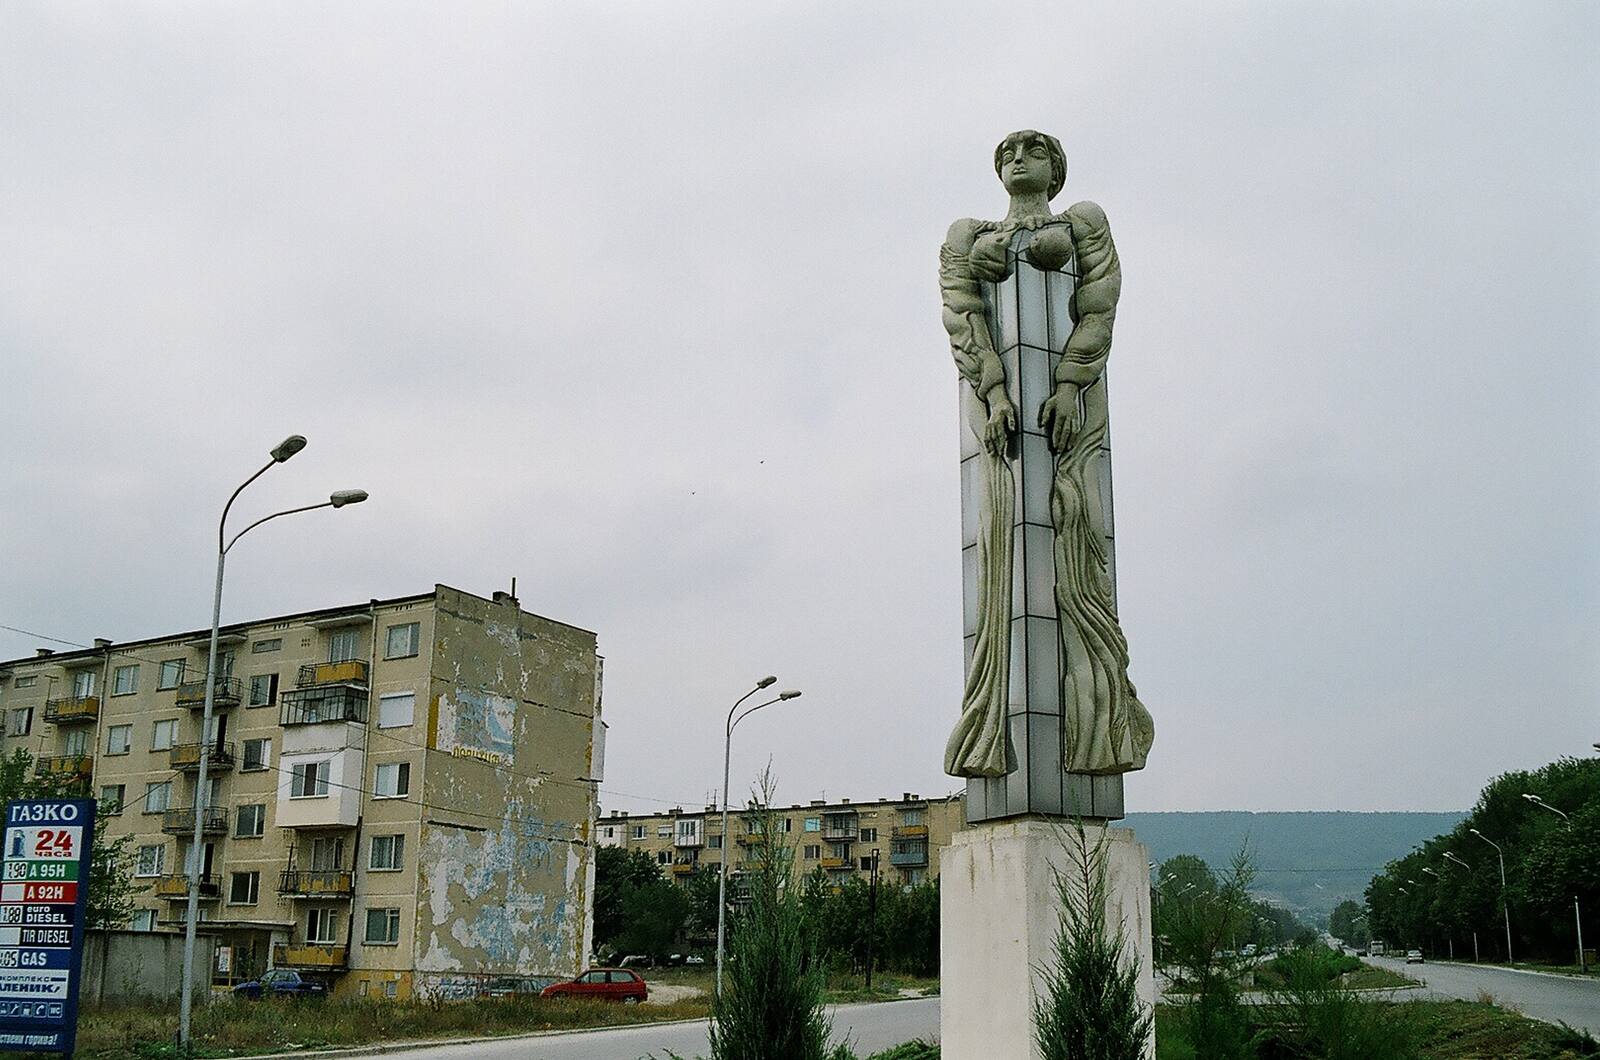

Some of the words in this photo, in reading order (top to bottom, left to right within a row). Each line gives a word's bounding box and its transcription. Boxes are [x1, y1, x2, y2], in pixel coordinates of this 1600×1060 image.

[11, 804, 78, 822] ГАЗКО
[35, 829, 73, 851] 24
[29, 863, 37, 878] A
[40, 863, 66, 878] 95H
[26, 885, 35, 899] A
[38, 885, 64, 900] 92H
[26, 905, 51, 913] euro
[26, 913, 67, 923] DIESEL
[22, 929, 36, 943] TIR
[37, 930, 70, 944] DIESEL
[21, 951, 48, 966] GAS
